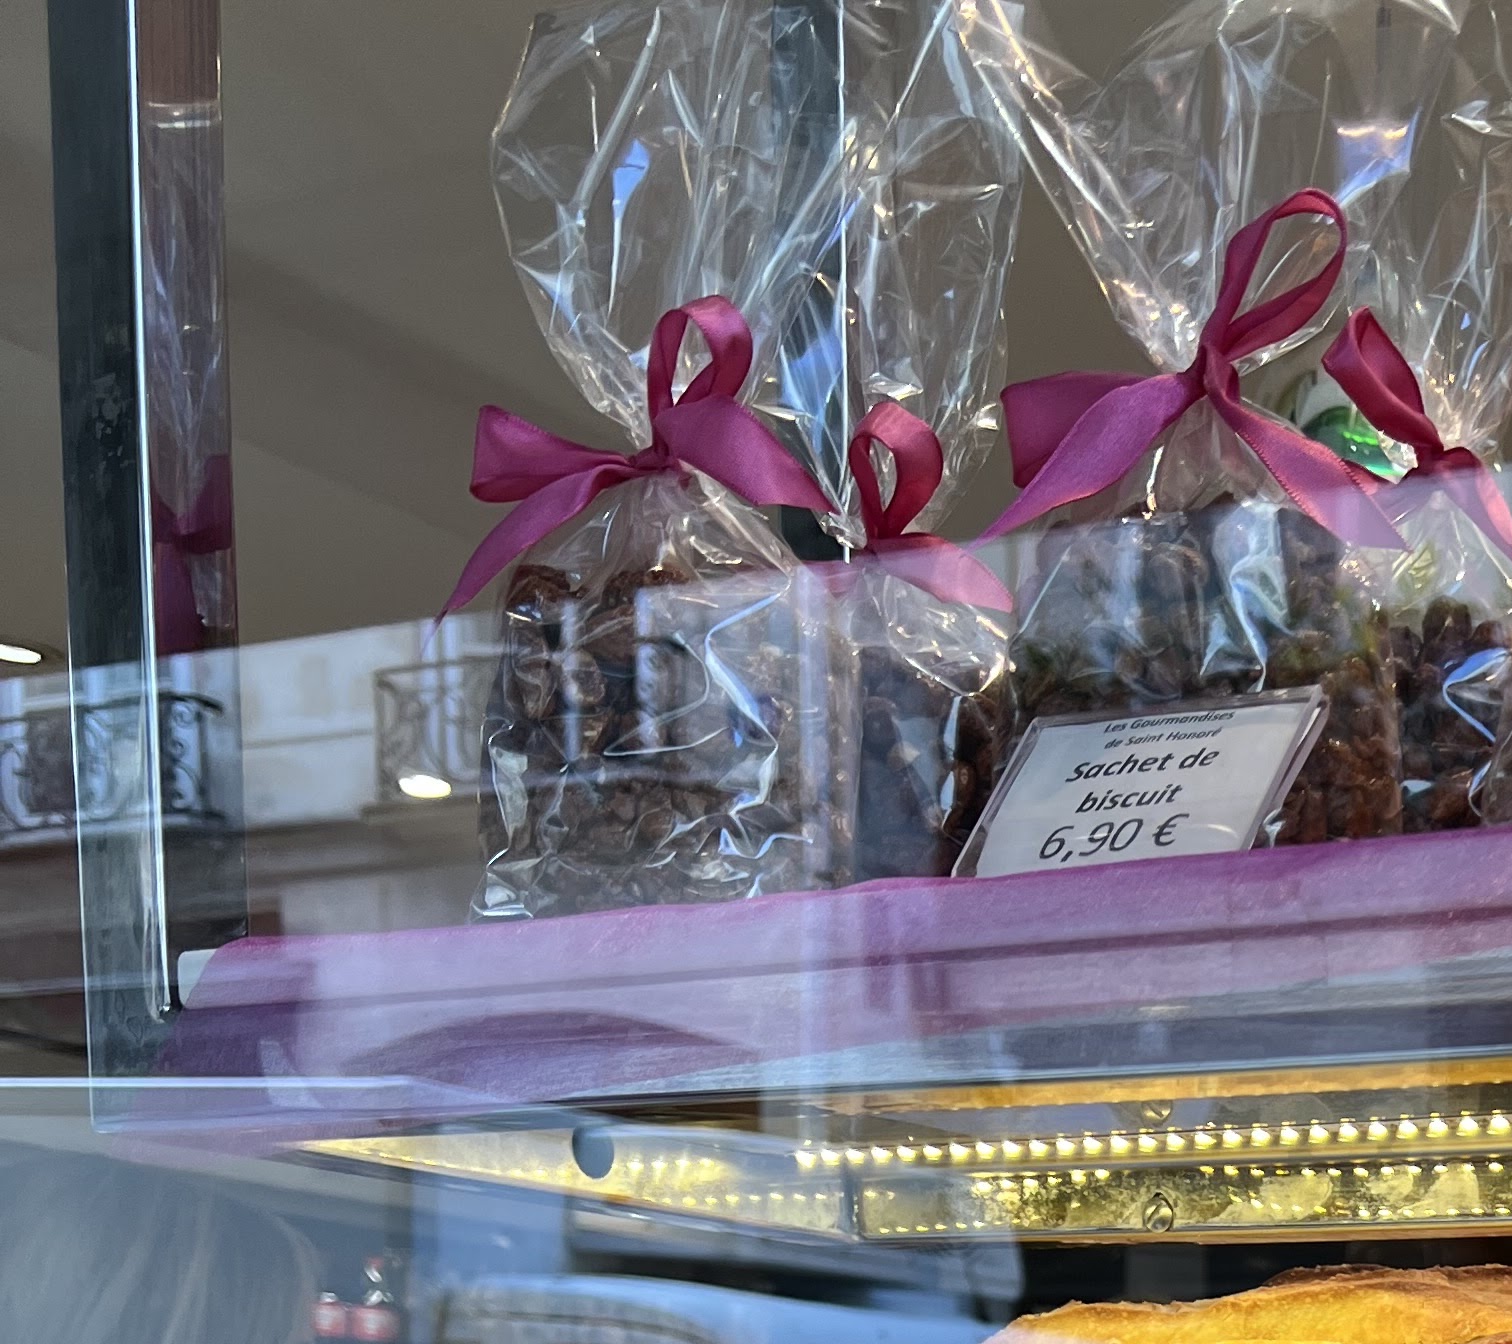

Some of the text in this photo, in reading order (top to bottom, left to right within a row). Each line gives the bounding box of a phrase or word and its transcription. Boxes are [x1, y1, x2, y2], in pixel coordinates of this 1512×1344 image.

[1103, 711, 1235, 734] Les Gourmandises
[1104, 726, 1223, 750] de Saint Honoré
[1065, 747, 1220, 783] Sachet de
[1075, 783, 1183, 814] biscuit
[1039, 813, 1190, 862] 6,90 €
